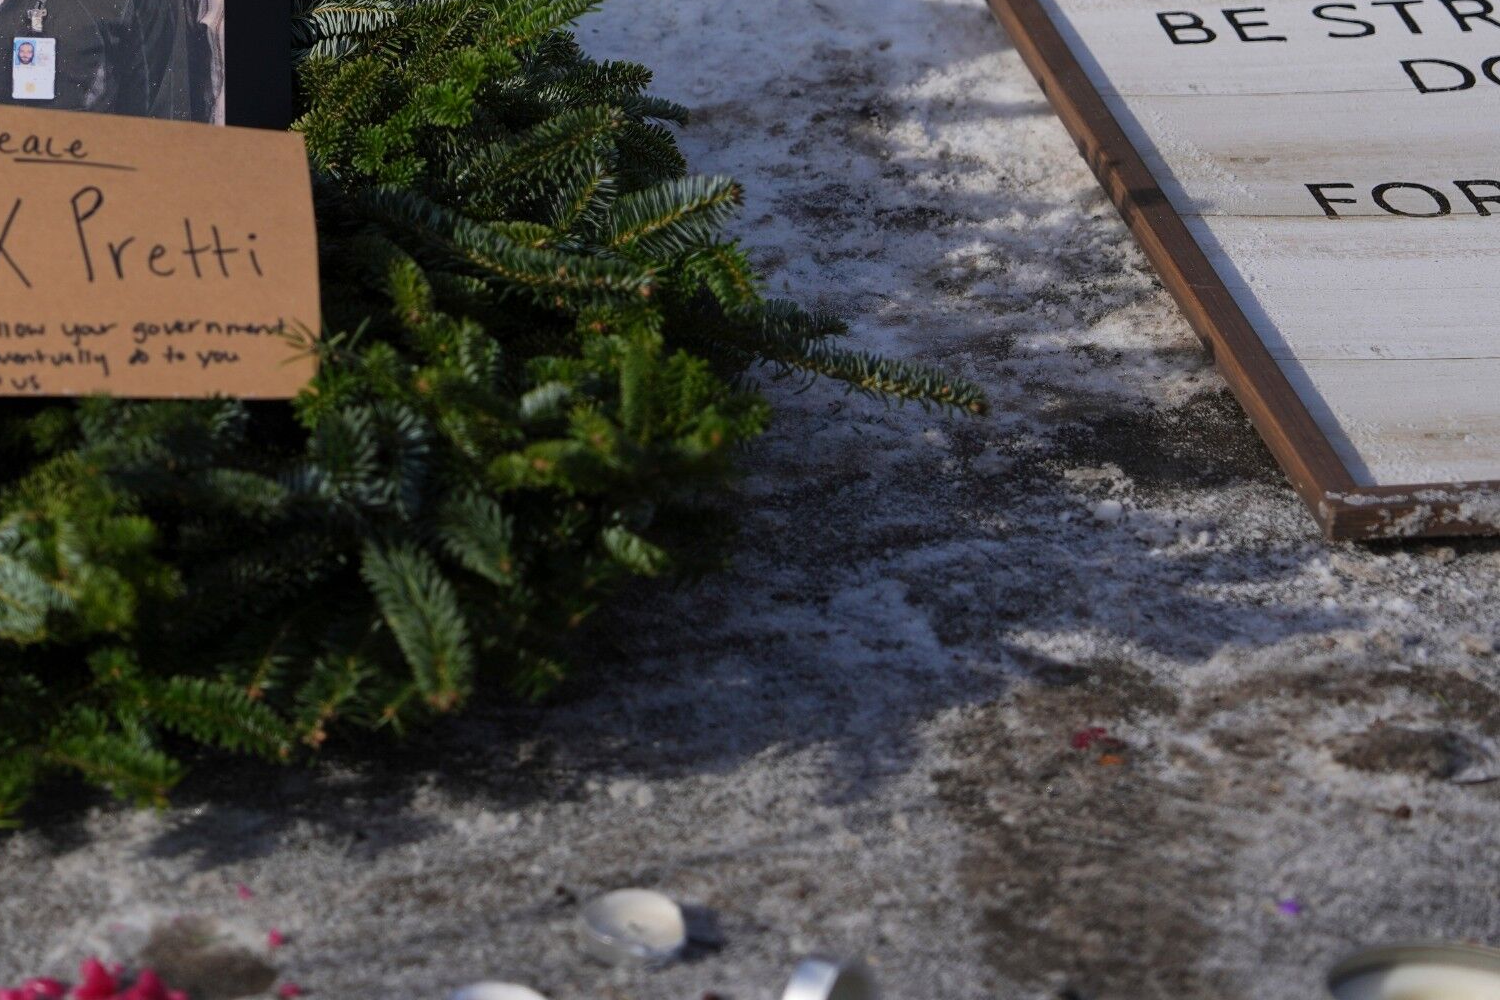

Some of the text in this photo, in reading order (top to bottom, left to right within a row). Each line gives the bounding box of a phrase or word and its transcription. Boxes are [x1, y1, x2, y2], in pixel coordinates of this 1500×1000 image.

[1156, 7, 1288, 45] BE
[1399, 55, 1500, 94] D
[70, 185, 264, 283] Pretti
